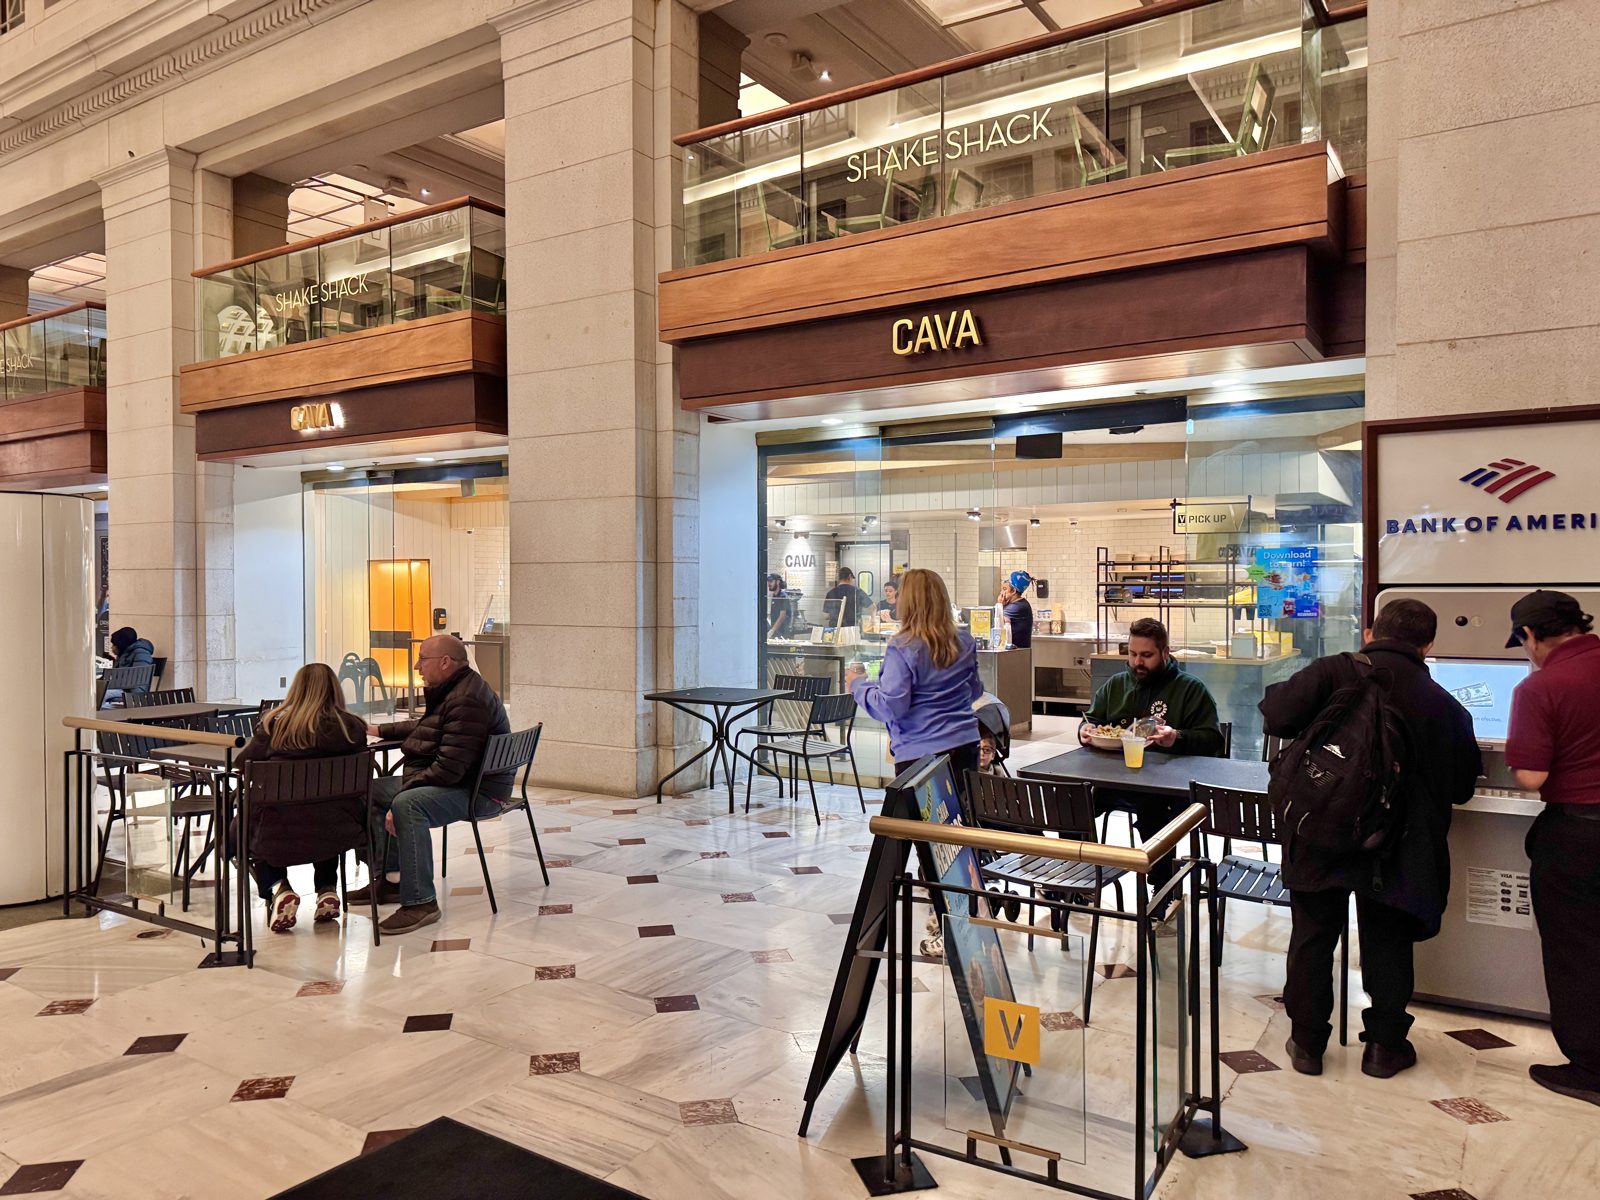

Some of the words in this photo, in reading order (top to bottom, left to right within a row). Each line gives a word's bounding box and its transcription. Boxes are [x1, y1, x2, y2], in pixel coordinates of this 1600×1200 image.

[846, 134, 939, 183] SHAKE
[945, 107, 1053, 160] SHACK
[275, 284, 319, 312] SHAKE
[320, 272, 368, 302] SHACK
[892, 309, 981, 355] CAVA
[6, 353, 34, 373] SHACK
[290, 403, 335, 431] CAVA
[1188, 514, 1211, 524] PICK
[1213, 514, 1227, 523] UP
[1386, 517, 1457, 534] BANK
[1464, 516, 1499, 532] OF
[1505, 512, 1597, 531] AMERI
[785, 554, 817, 568] CAVA
[1263, 550, 1312, 560] Download
[1269, 560, 1279, 568] to
[998, 1009, 1026, 1050] V
